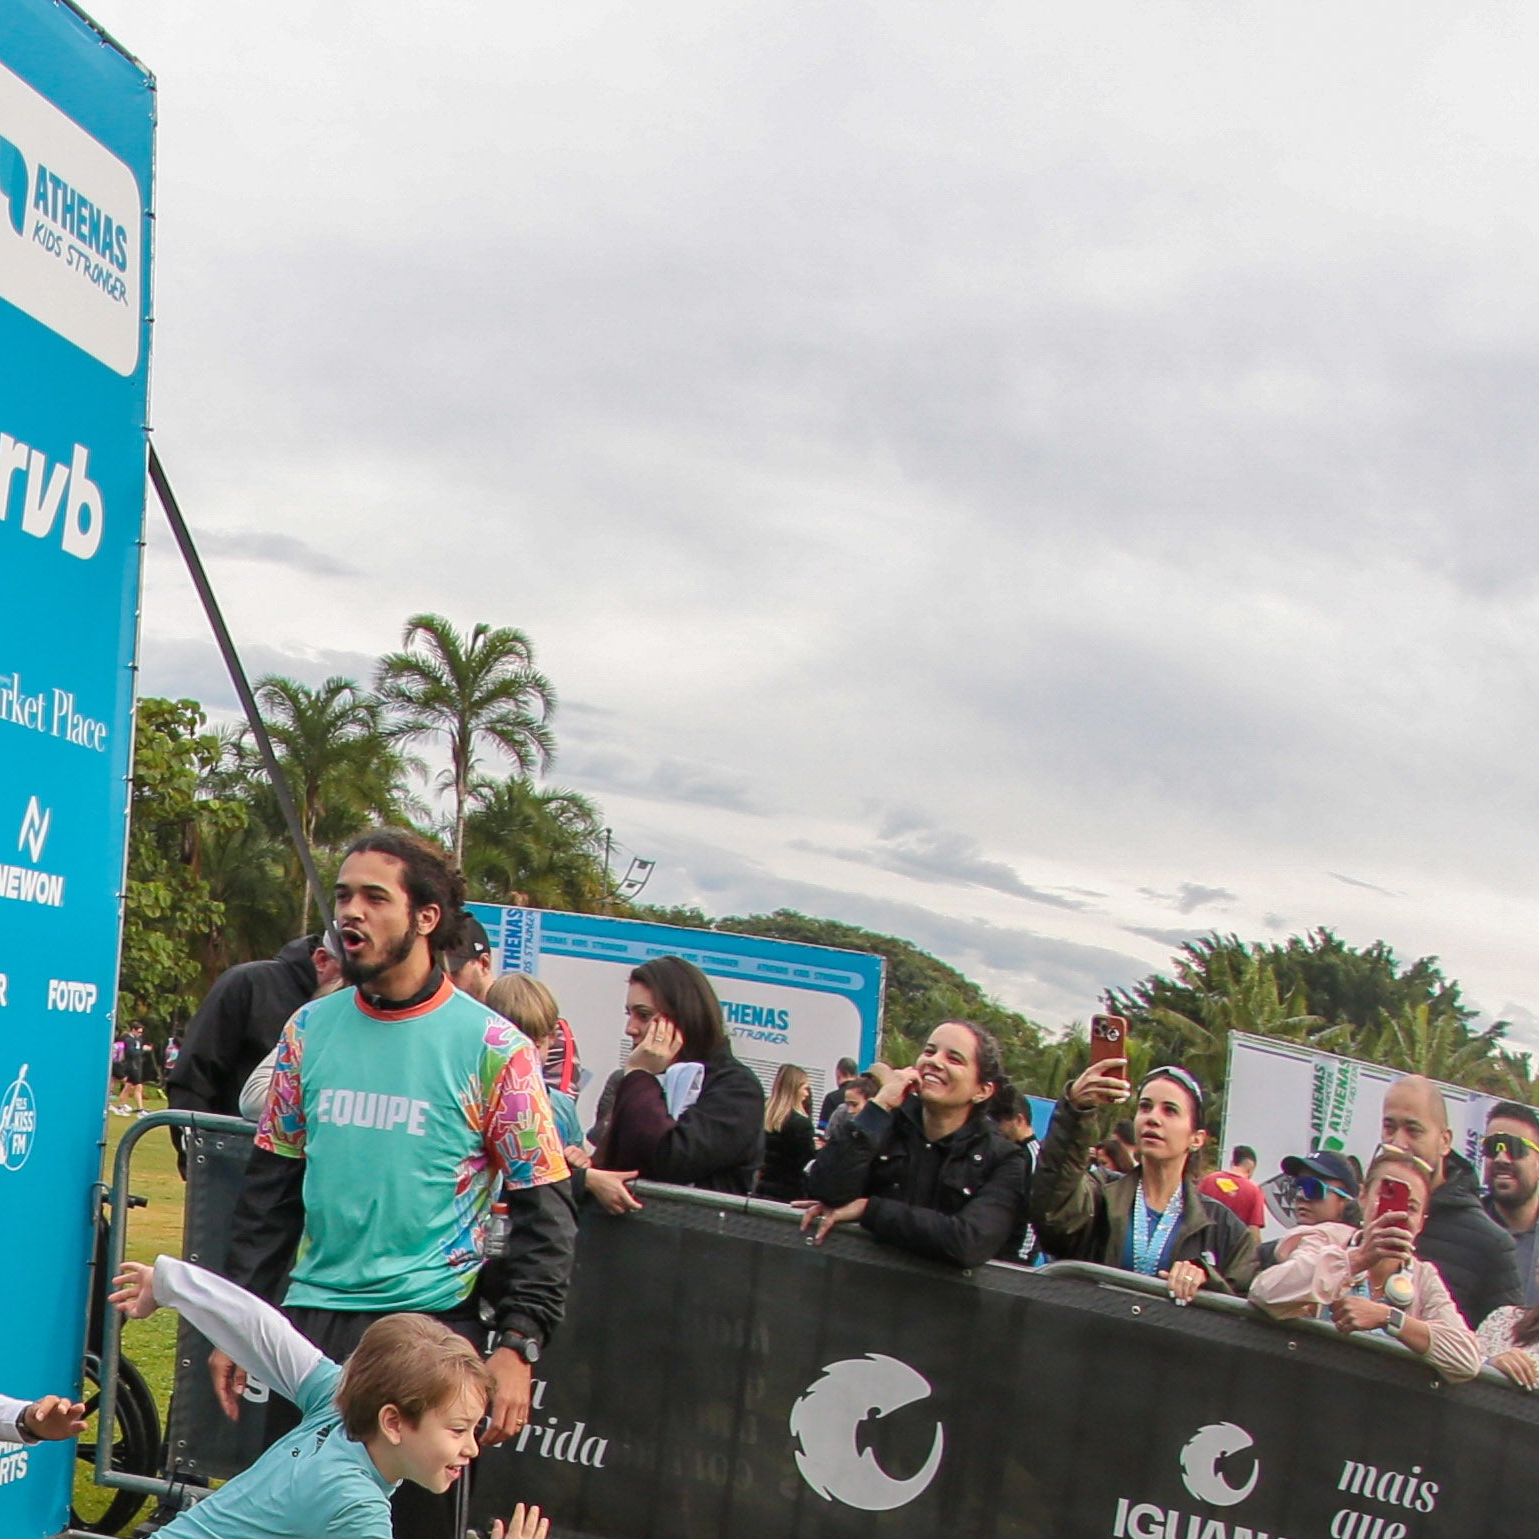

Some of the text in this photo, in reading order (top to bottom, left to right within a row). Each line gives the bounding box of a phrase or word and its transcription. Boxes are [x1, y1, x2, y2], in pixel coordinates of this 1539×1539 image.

[33, 163, 127, 273] ATHENAS
[32, 220, 128, 307] KIDS STRONGER
[51, 688, 108, 752] Place
[503, 908, 522, 974] THENAS
[731, 1027, 789, 1045] STRONGER
[317, 1089, 426, 1137] EQUIPE
[12, 1134, 27, 1154] FM
[1337, 1460, 1440, 1513] mais
